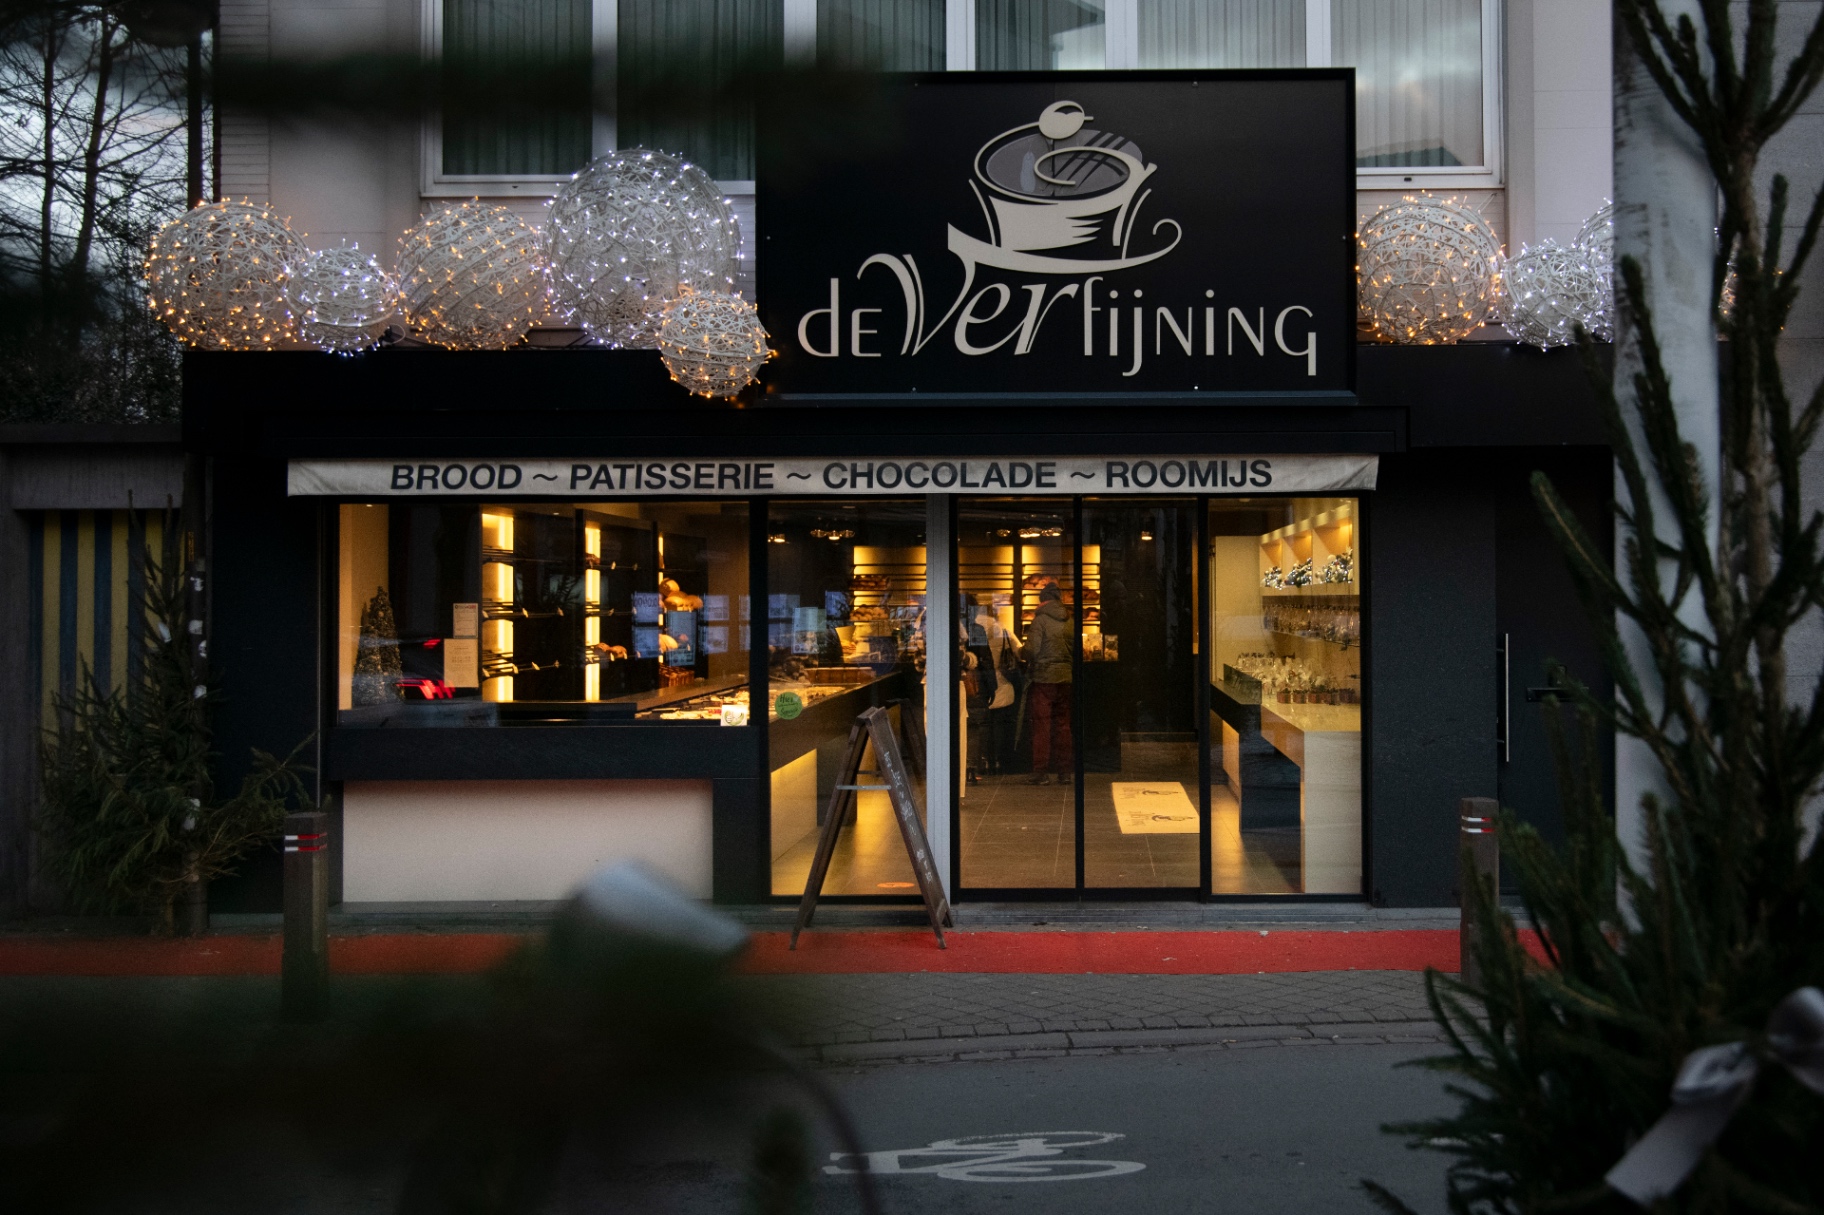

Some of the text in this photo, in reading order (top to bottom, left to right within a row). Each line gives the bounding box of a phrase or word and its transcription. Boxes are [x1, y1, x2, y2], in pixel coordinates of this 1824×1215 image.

[390, 463, 522, 490] BROOD
[569, 463, 775, 490] PATISSERIE
[822, 462, 1057, 489] CHOCOLADE
[1105, 460, 1272, 488] ROOMIJS
